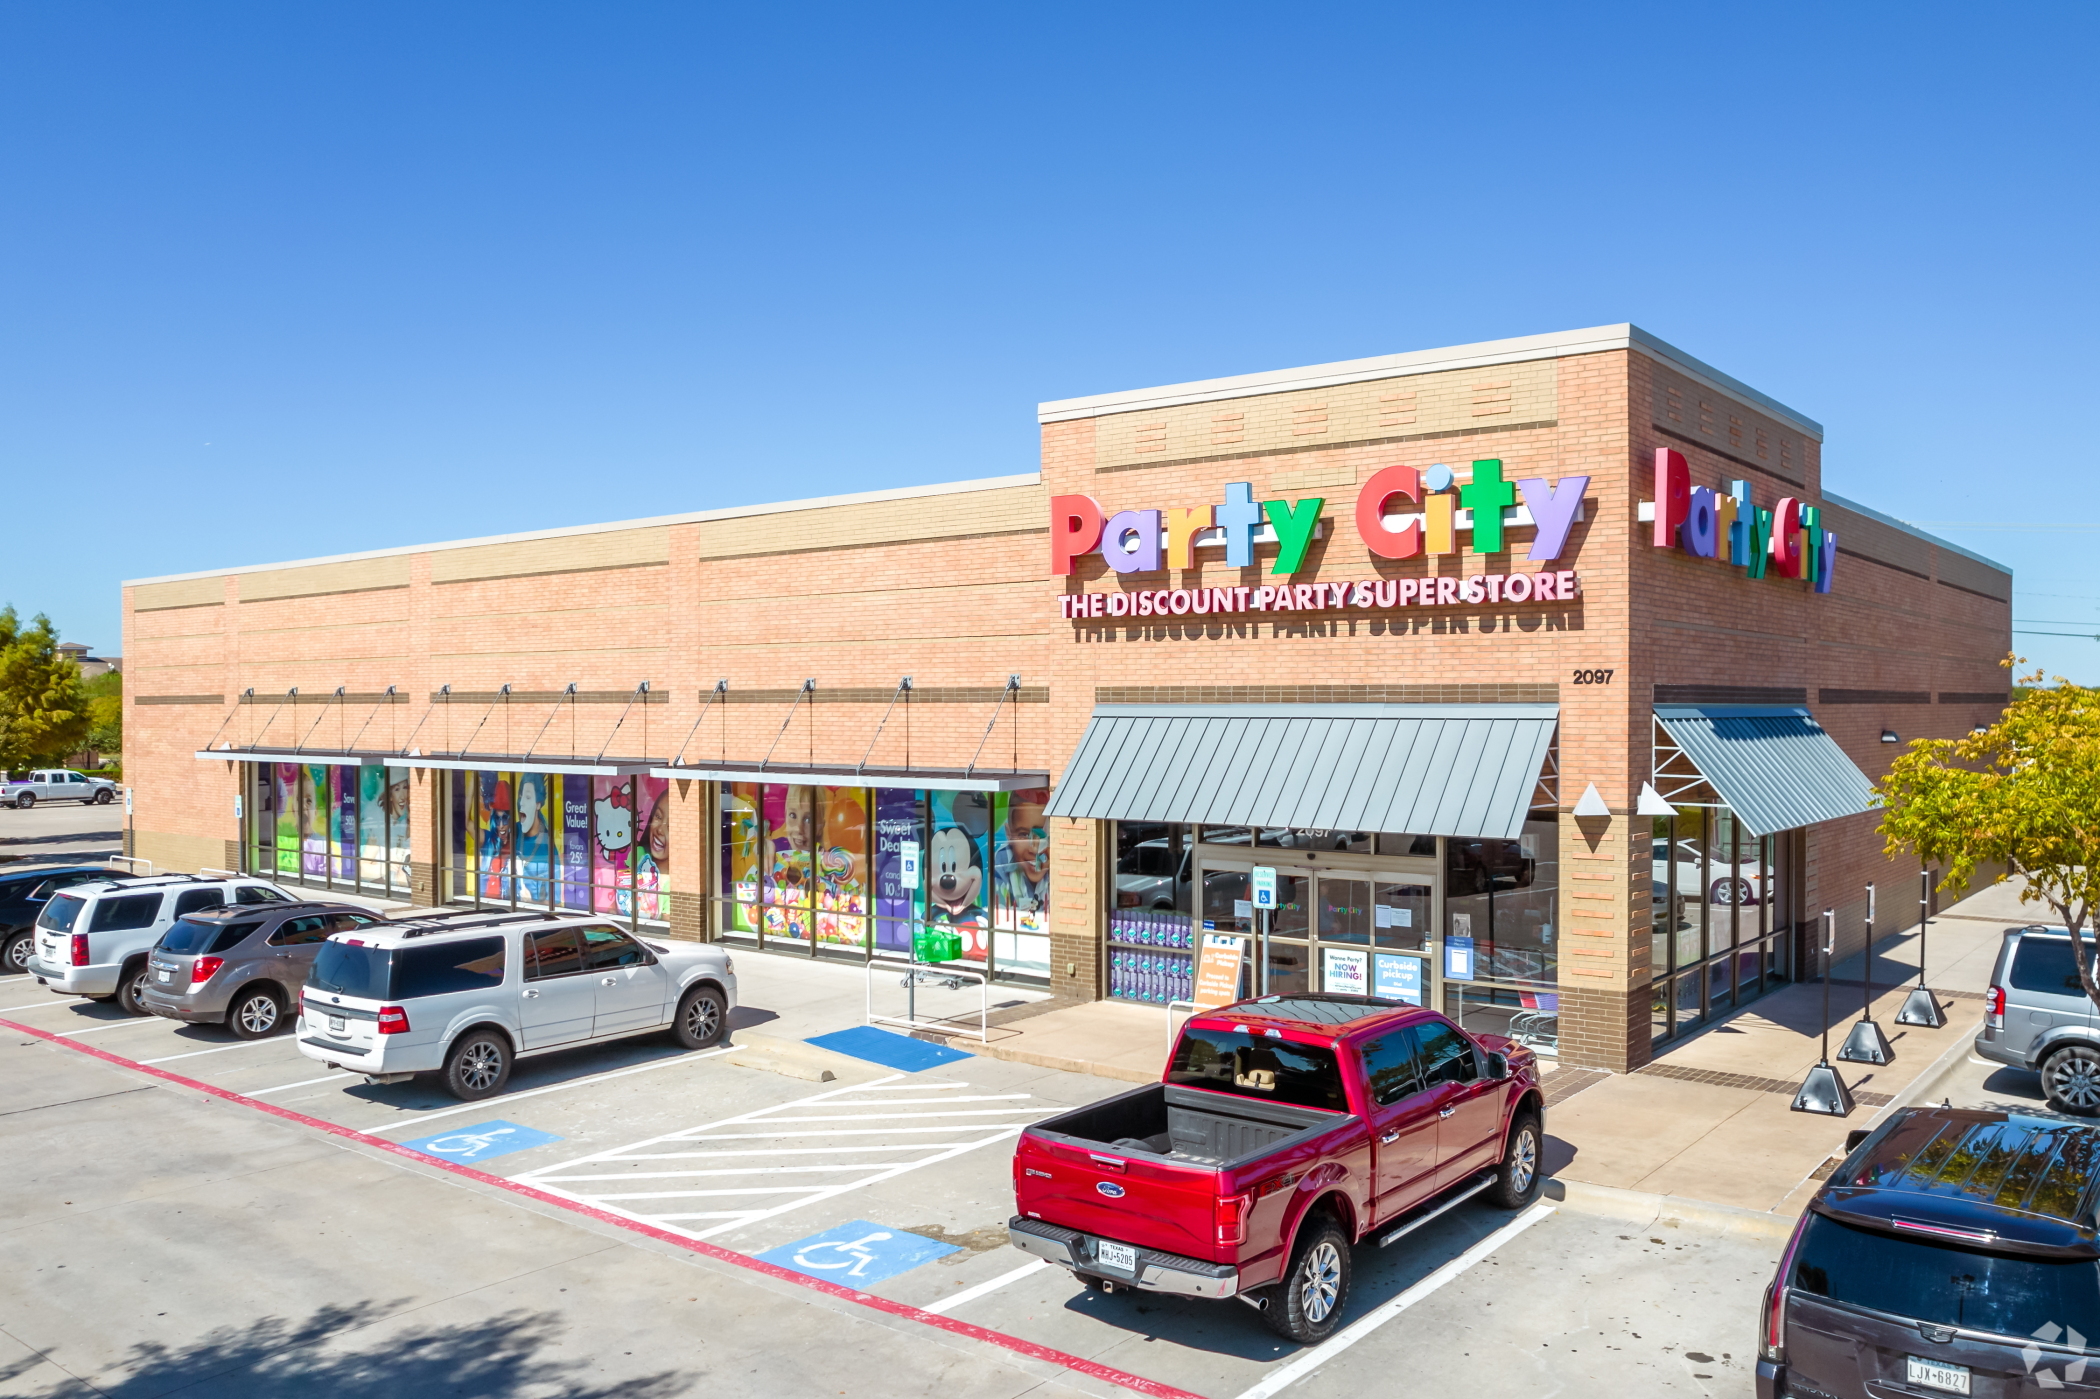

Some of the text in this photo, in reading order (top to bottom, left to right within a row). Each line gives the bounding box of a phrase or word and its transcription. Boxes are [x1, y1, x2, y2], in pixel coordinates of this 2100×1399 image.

[1050, 459, 1591, 575] Party City
[1654, 447, 1838, 593] Party City
[1057, 570, 1579, 619] THE DISCOUNT PARTY SUPER STORE
[1573, 669, 1614, 685] 2097
[565, 800, 588, 814] Great
[565, 814, 588, 829] Value!
[880, 819, 911, 835] Sweet
[1328, 904, 1362, 916] Party City
[1334, 962, 1357, 972] NOW
[1378, 959, 1418, 972] Curbside
[1329, 970, 1362, 981] HIRING!
[1382, 969, 1414, 982] pickup
[1110, 1244, 1124, 1252] TEXAS
[1927, 1359, 1952, 1370] TEXAS
